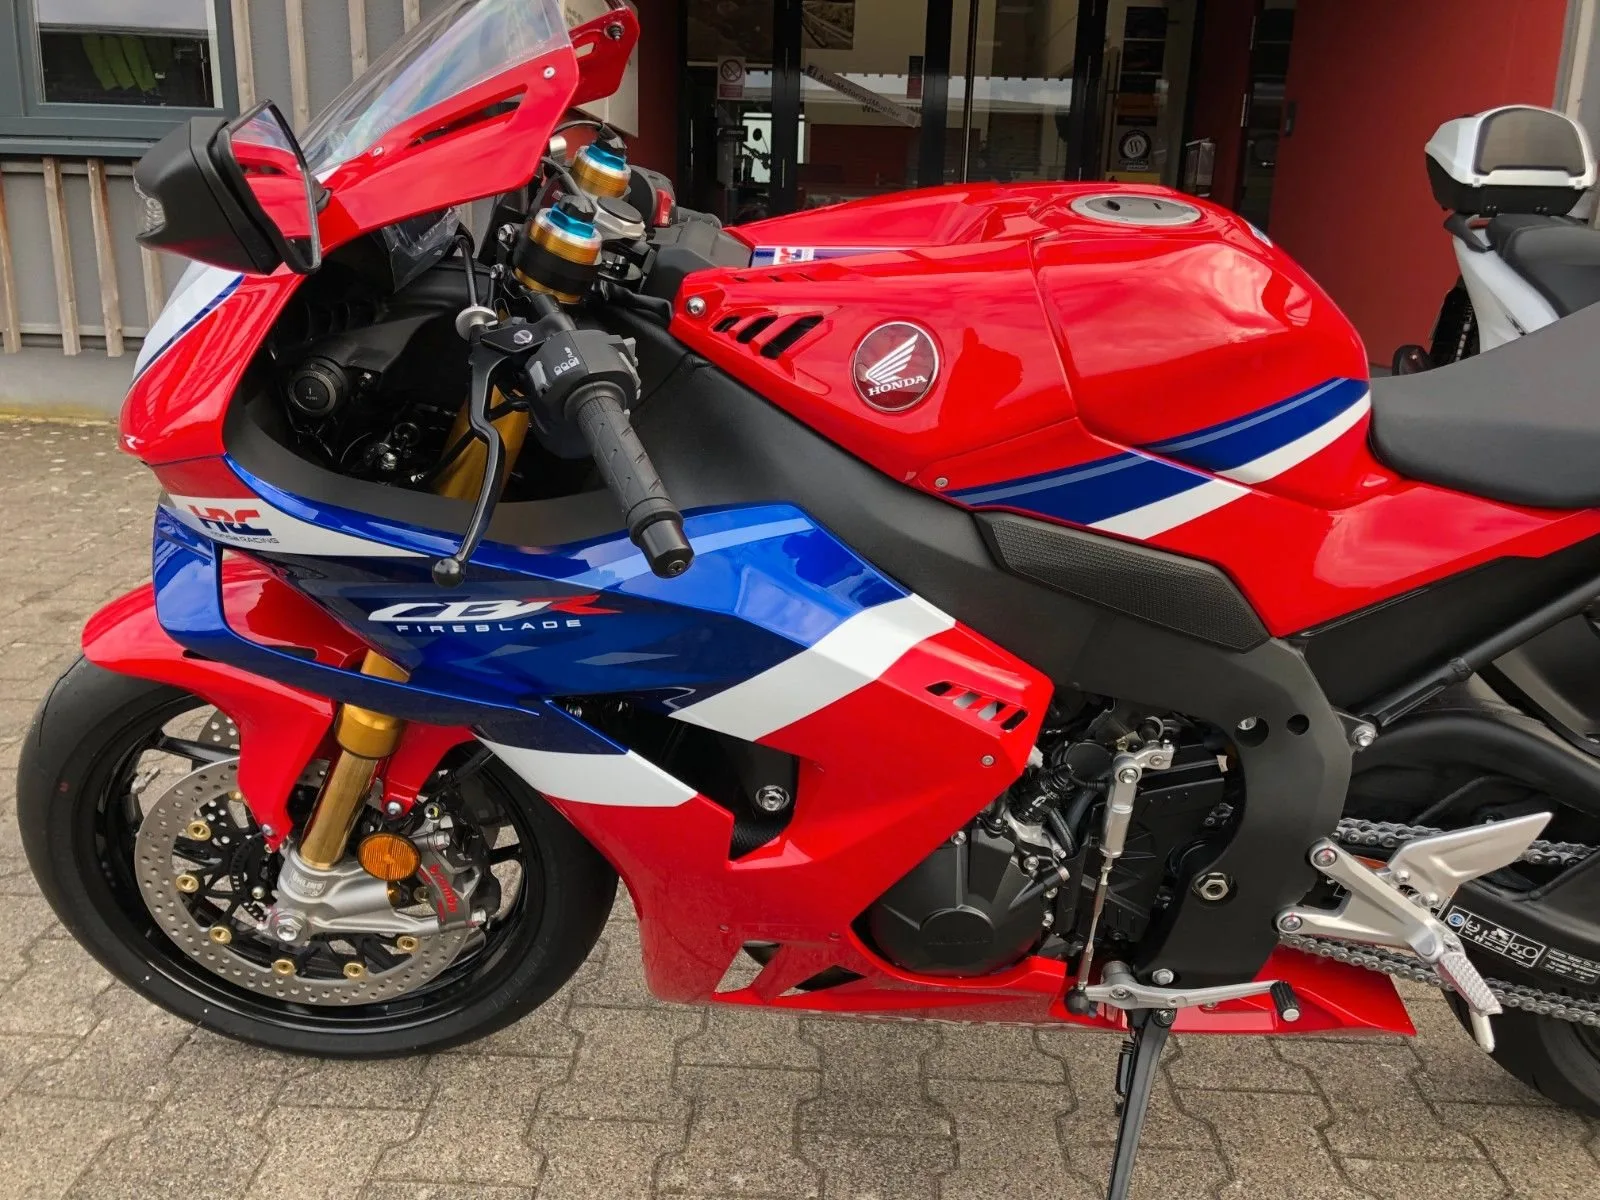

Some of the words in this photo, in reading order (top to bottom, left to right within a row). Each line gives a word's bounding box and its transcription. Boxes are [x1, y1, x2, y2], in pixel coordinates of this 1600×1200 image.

[868, 374, 928, 397] HONDA
[187, 504, 273, 536] HRC
[238, 535, 280, 544] RACING
[367, 594, 624, 623] CBR
[396, 618, 583, 634] FIREBLADE
